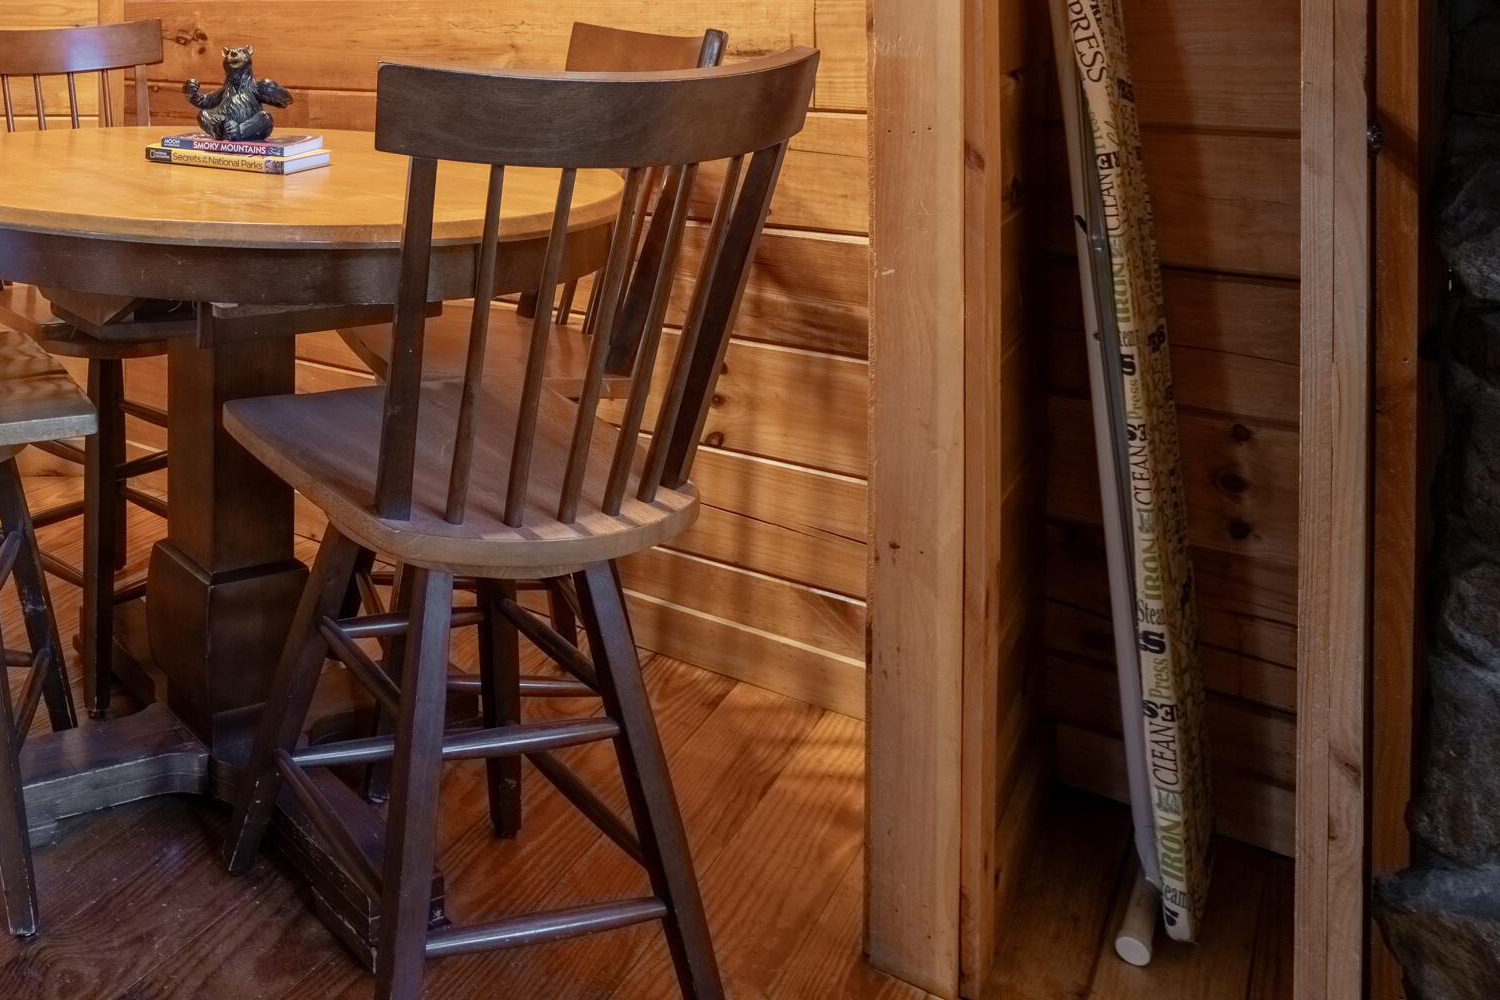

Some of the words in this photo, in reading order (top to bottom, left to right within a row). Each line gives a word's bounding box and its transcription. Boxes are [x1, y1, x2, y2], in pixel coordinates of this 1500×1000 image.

[172, 152, 202, 163] Secrets
[208, 157, 240, 168] National
[241, 159, 263, 171] Parks
[193, 141, 220, 151] SMOKY
[220, 143, 266, 155] MOUNTAINS
[1129, 379, 1144, 420] Press
[1128, 445, 1152, 505] CLEAN
[1141, 538, 1162, 601] IRON
[1148, 658, 1173, 700] Press
[1150, 721, 1180, 786] CLEAN
[1159, 815, 1185, 883] IRON
